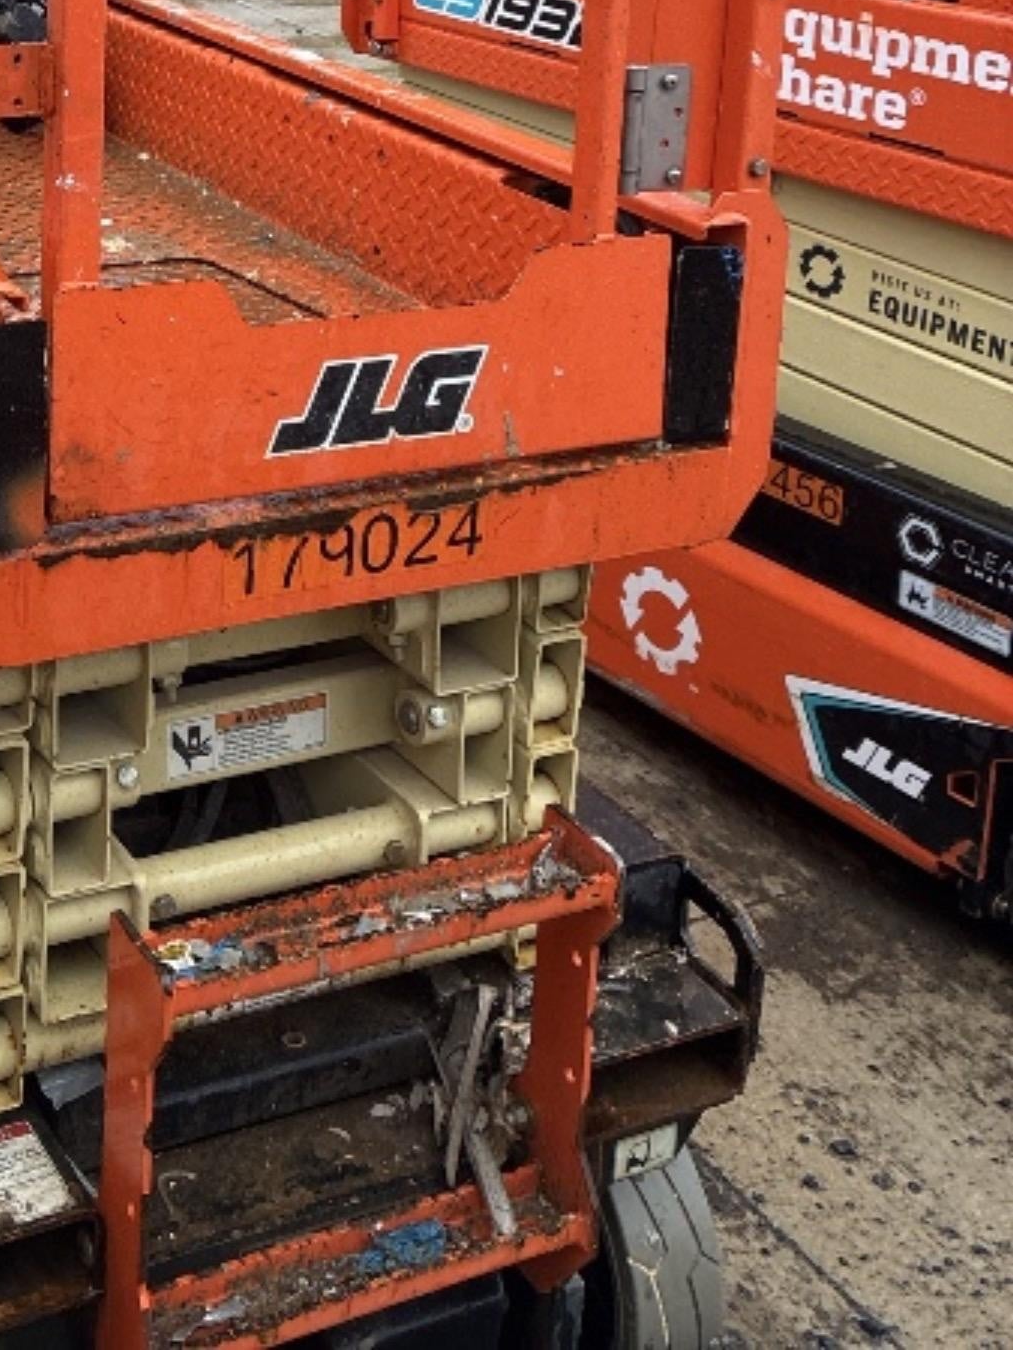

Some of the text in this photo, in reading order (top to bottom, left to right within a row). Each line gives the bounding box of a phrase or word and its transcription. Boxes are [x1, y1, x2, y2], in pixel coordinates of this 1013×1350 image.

[784, 7, 1013, 96] quipme
[264, 344, 489, 458] JLG
[232, 502, 483, 596] 179024
[842, 737, 933, 799] JLG
